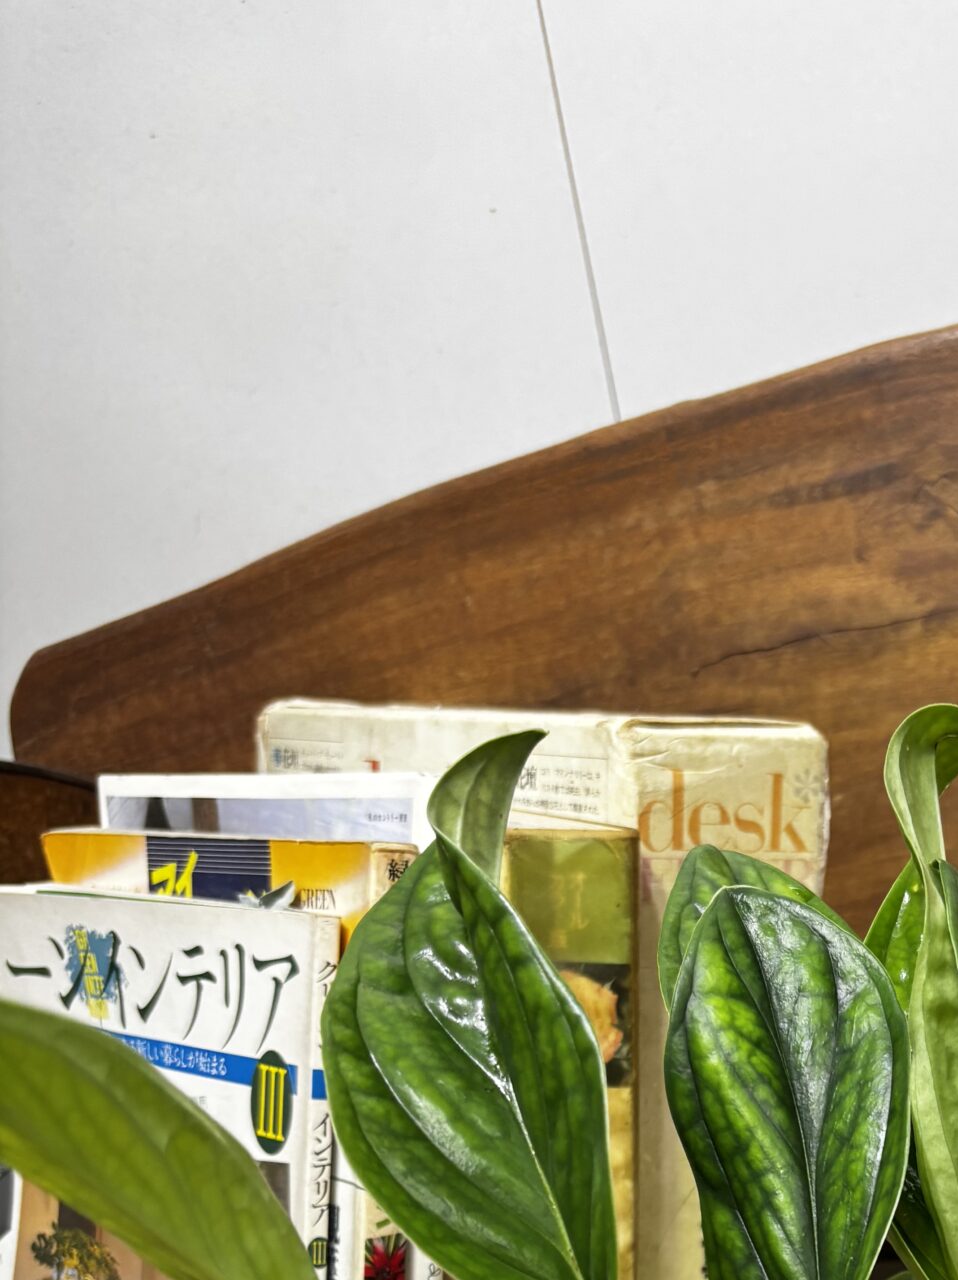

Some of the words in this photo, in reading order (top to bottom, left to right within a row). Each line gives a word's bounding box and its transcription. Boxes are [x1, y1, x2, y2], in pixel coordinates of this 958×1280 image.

[638, 768, 811, 853] desk
[299, 887, 337, 910] GREEN
[256, 1063, 287, 1142] III
[312, 1113, 333, 1227] インテリア
